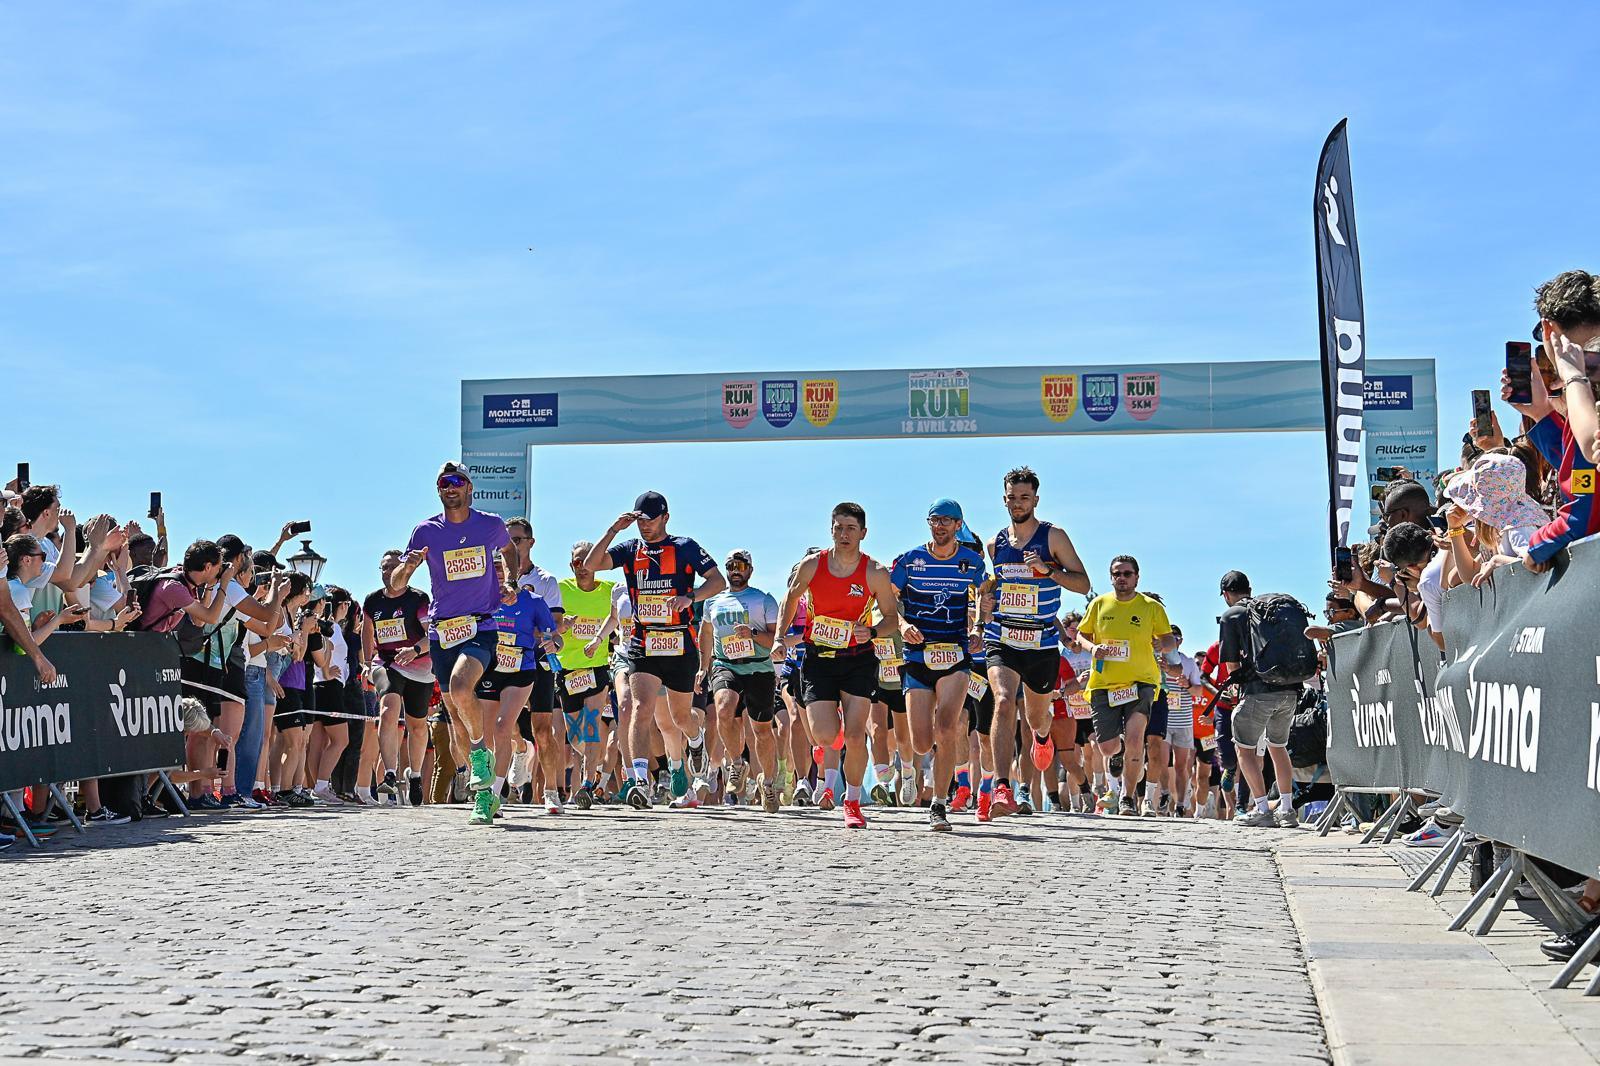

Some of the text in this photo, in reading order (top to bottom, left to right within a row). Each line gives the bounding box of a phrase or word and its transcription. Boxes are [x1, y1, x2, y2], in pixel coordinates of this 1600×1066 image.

[910, 378, 969, 388] MONTPELLIER
[1045, 383, 1073, 397] RUN
[1086, 383, 1115, 397] RUN
[1127, 382, 1155, 396] RUN
[725, 388, 753, 404] RUN
[766, 388, 794, 403] RUN
[806, 388, 833, 402] RUN
[1092, 397, 1111, 406] 5KM
[772, 403, 790, 412] 5KM
[910, 388, 969, 418] RUN
[1132, 400, 1152, 409] 5KM
[489, 409, 553, 418] MONTPELLIER
[730, 408, 749, 418] 5KM
[901, 420, 977, 432] 18 AVRIL 2026
[1375, 445, 1427, 454] Alltricks
[469, 465, 517, 474] Alltricks
[1581, 474, 1591, 488] 3
[473, 489, 510, 499] atmut
[446, 556, 485, 574] 25255-1
[1001, 593, 1036, 607] 25165-1
[639, 604, 671, 616] 25392-1
[716, 610, 750, 626] RUN
[377, 625, 405, 638] 25283-1
[443, 624, 472, 642] 25255
[813, 622, 849, 642] 25418-1
[1008, 628, 1035, 642] 25165
[651, 637, 678, 650] 25392
[930, 651, 958, 663] 25163
[155, 669, 162, 684] by
[569, 674, 592, 689] 25263
[34, 675, 41, 693] by
[1351, 673, 1397, 748] Runna
